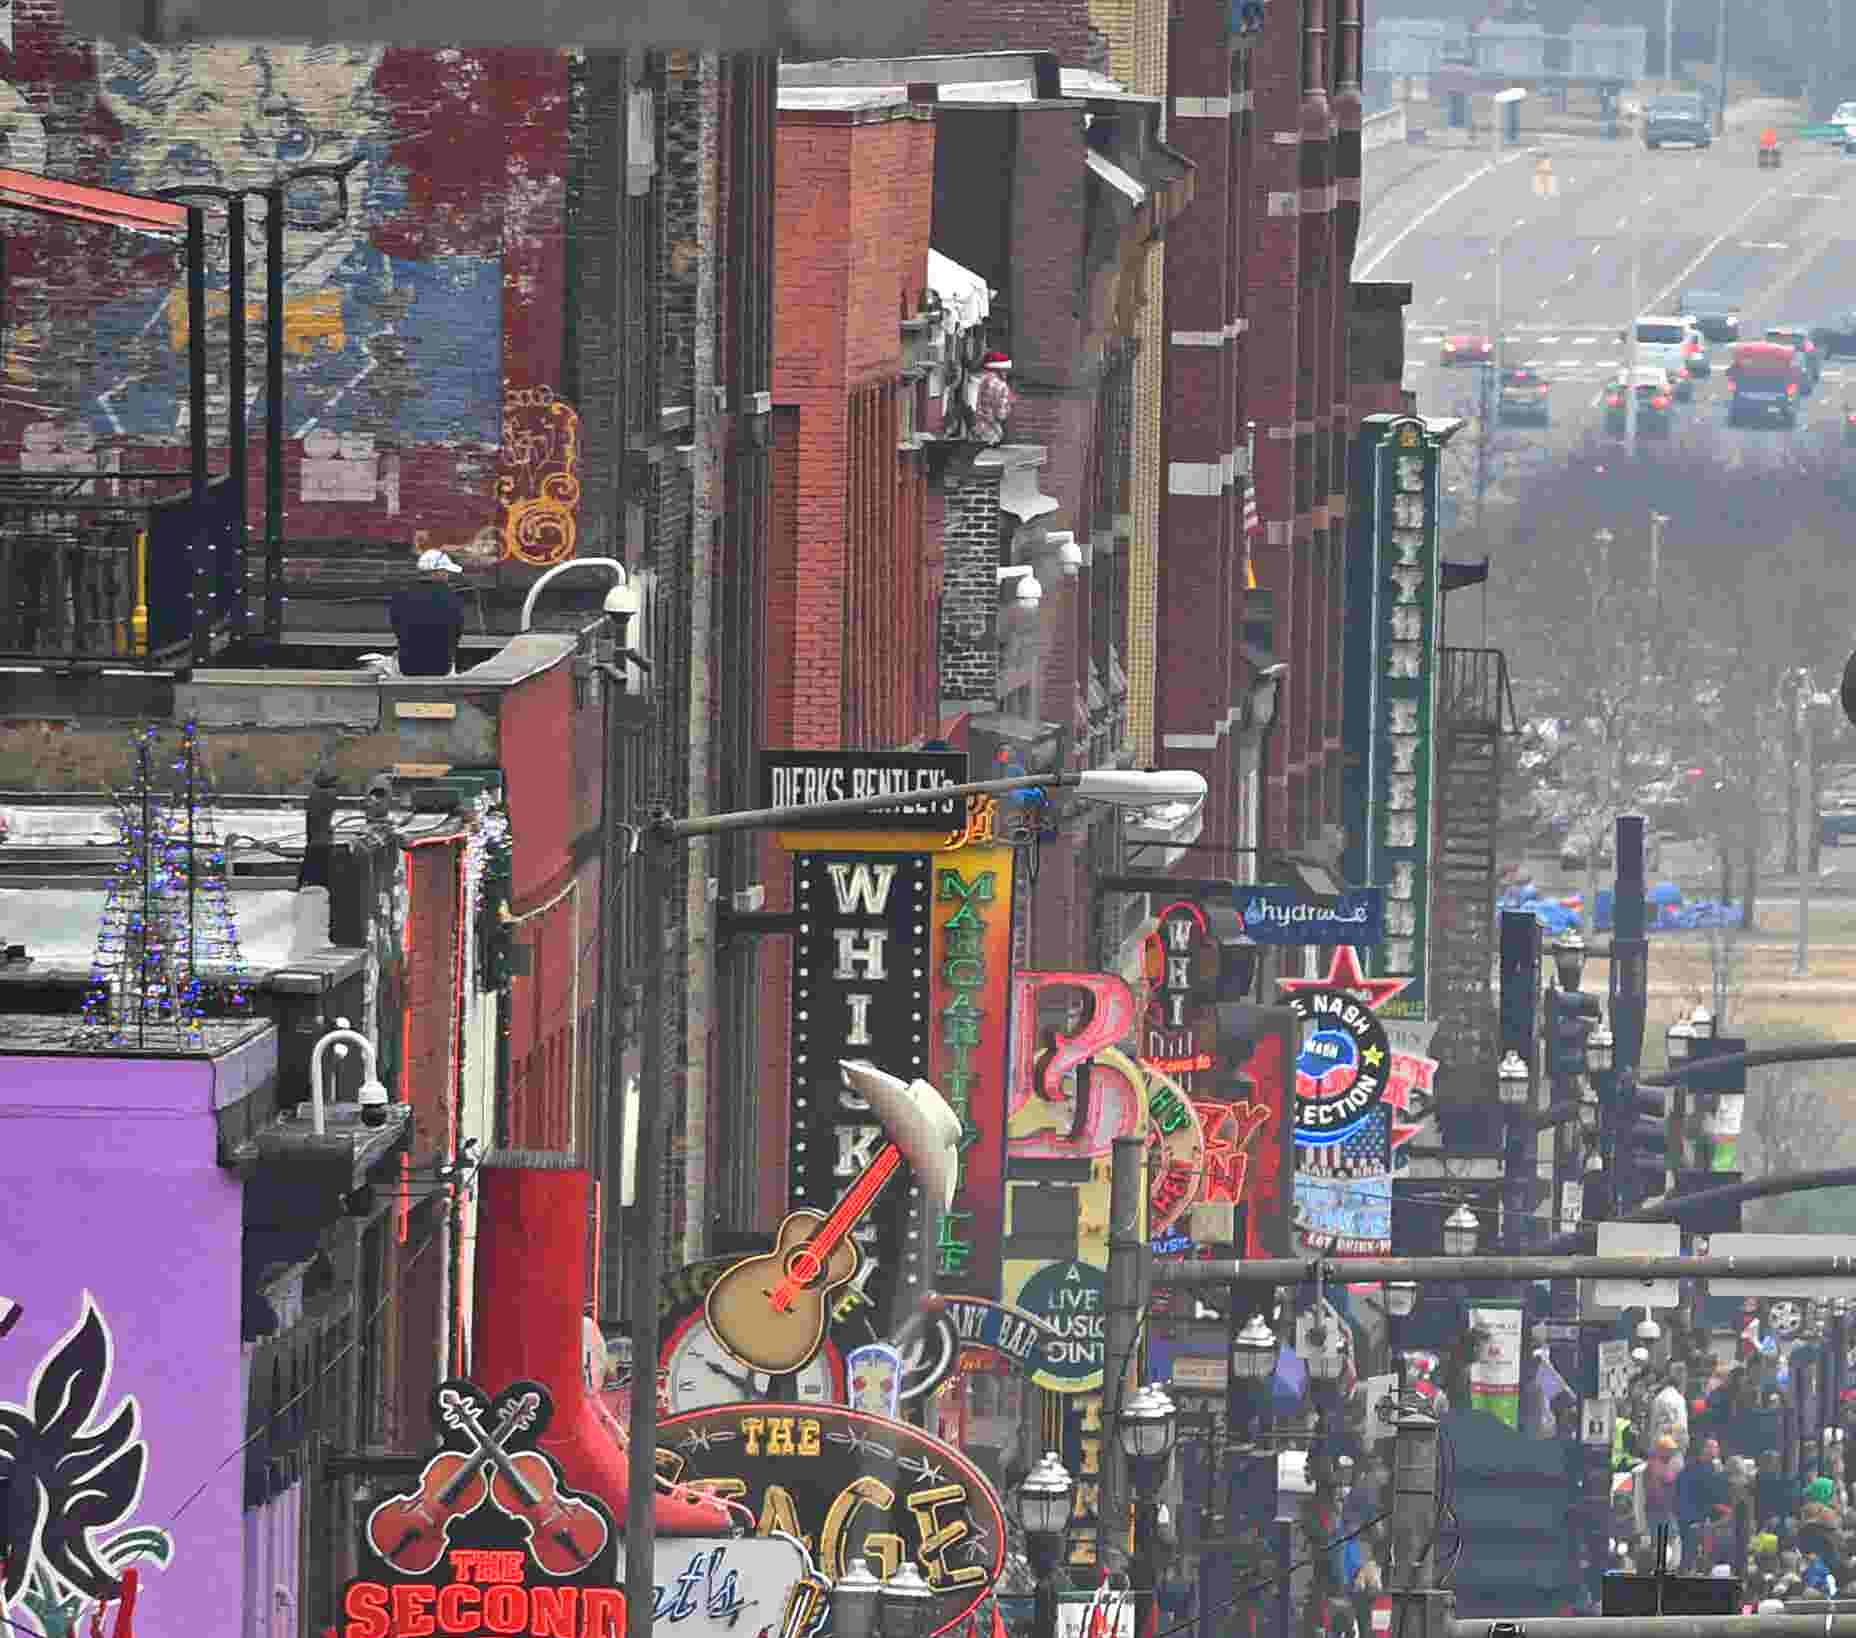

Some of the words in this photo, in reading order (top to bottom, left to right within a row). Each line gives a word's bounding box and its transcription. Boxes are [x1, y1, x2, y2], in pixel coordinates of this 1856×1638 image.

[1065, 1266, 1081, 1284] A
[741, 1417, 823, 1457] THE
[449, 1550, 526, 1585] THE
